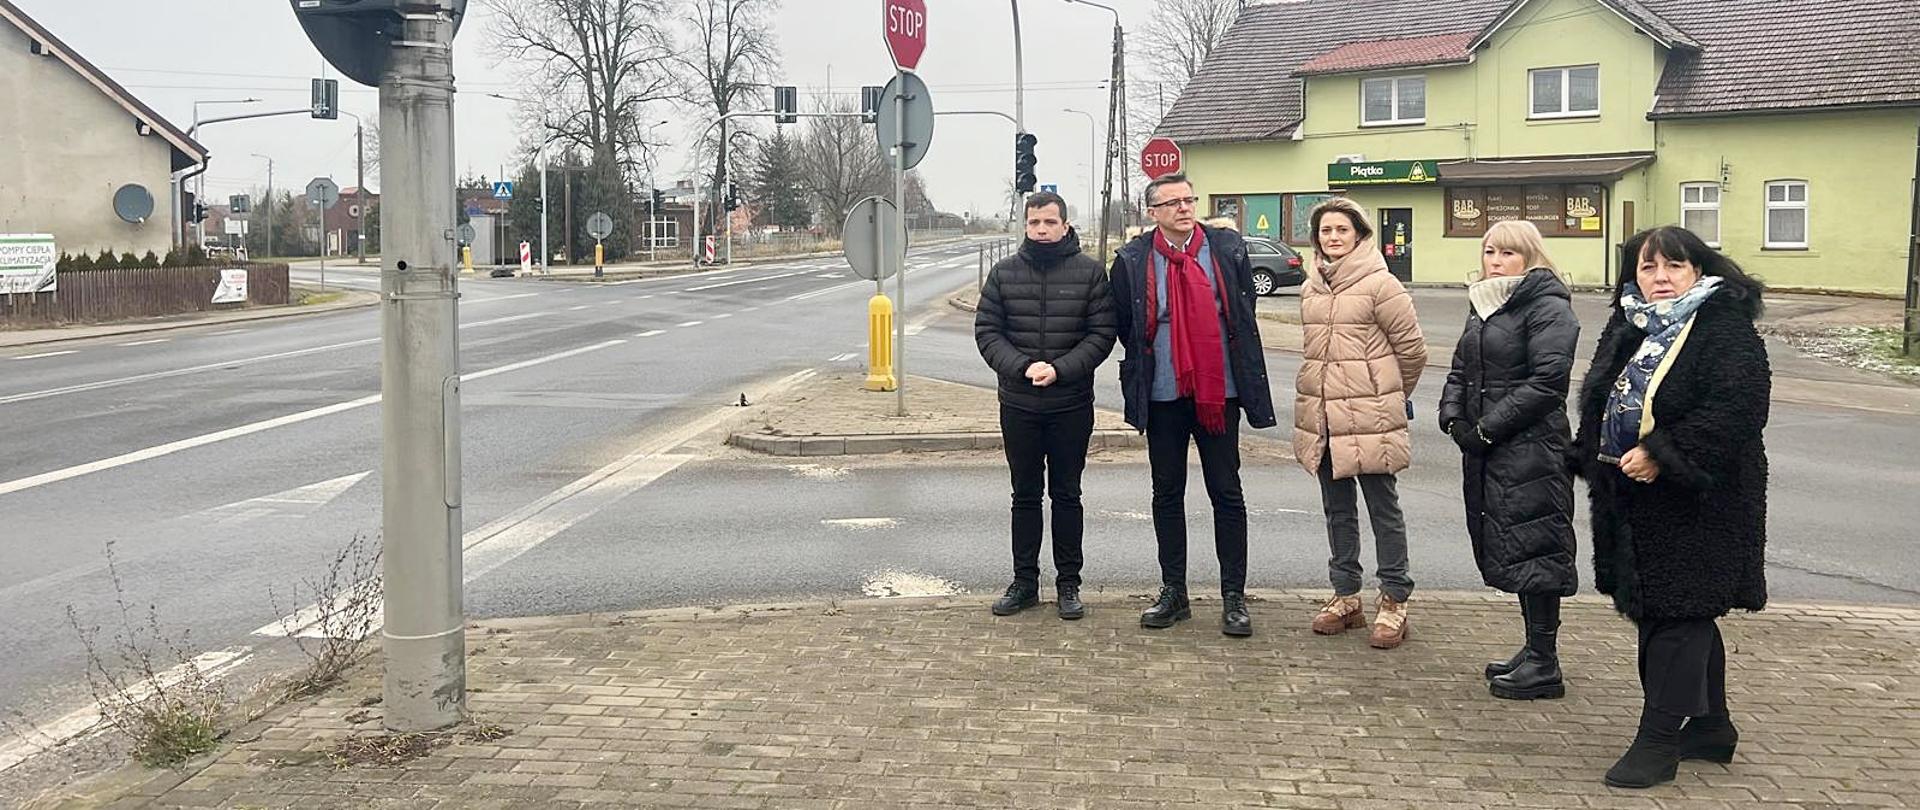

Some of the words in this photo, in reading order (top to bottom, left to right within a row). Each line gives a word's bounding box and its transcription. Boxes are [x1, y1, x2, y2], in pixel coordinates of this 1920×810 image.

[890, 4, 922, 39] STOP
[1145, 153, 1177, 168] STOP
[1454, 200, 1473, 212] BAR
[1567, 197, 1589, 211] BAR
